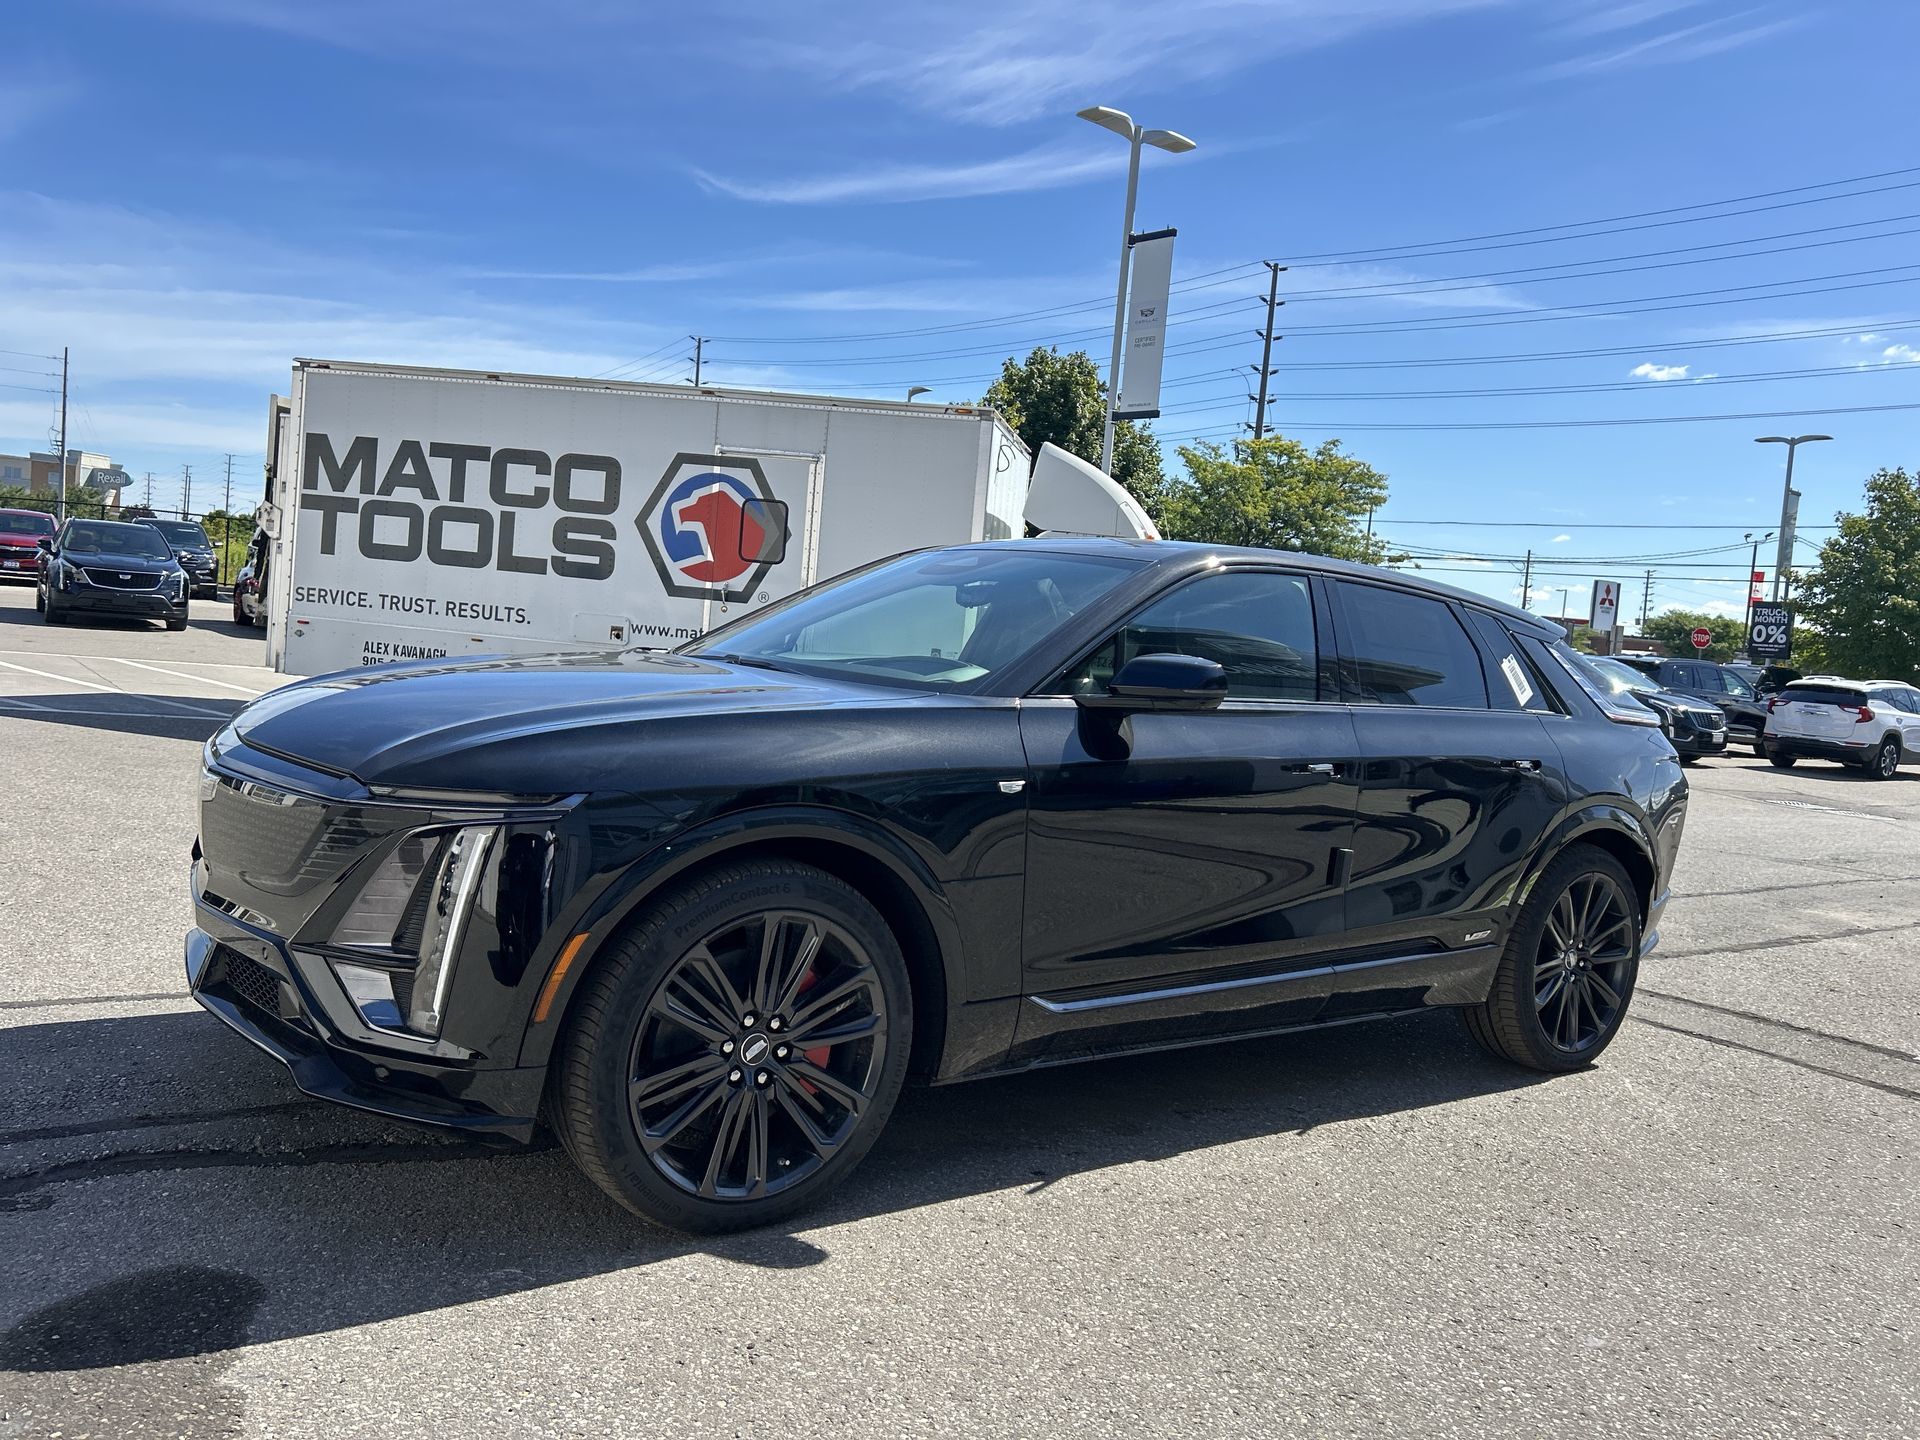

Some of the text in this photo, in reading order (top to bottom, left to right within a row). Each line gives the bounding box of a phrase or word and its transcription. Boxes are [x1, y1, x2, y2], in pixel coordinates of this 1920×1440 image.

[97, 471, 126, 484] Rexall
[302, 433, 622, 516] MATCO
[300, 493, 617, 581] TOOLS
[295, 586, 531, 624] SERVICE. TRUST. RESULTS.
[1755, 607, 1789, 617] TRUCK
[1754, 615, 1788, 624] MONTH
[1693, 633, 1710, 643] STOP
[1752, 624, 1787, 644] 0%
[363, 640, 447, 659] ALEX KAVANAGH
